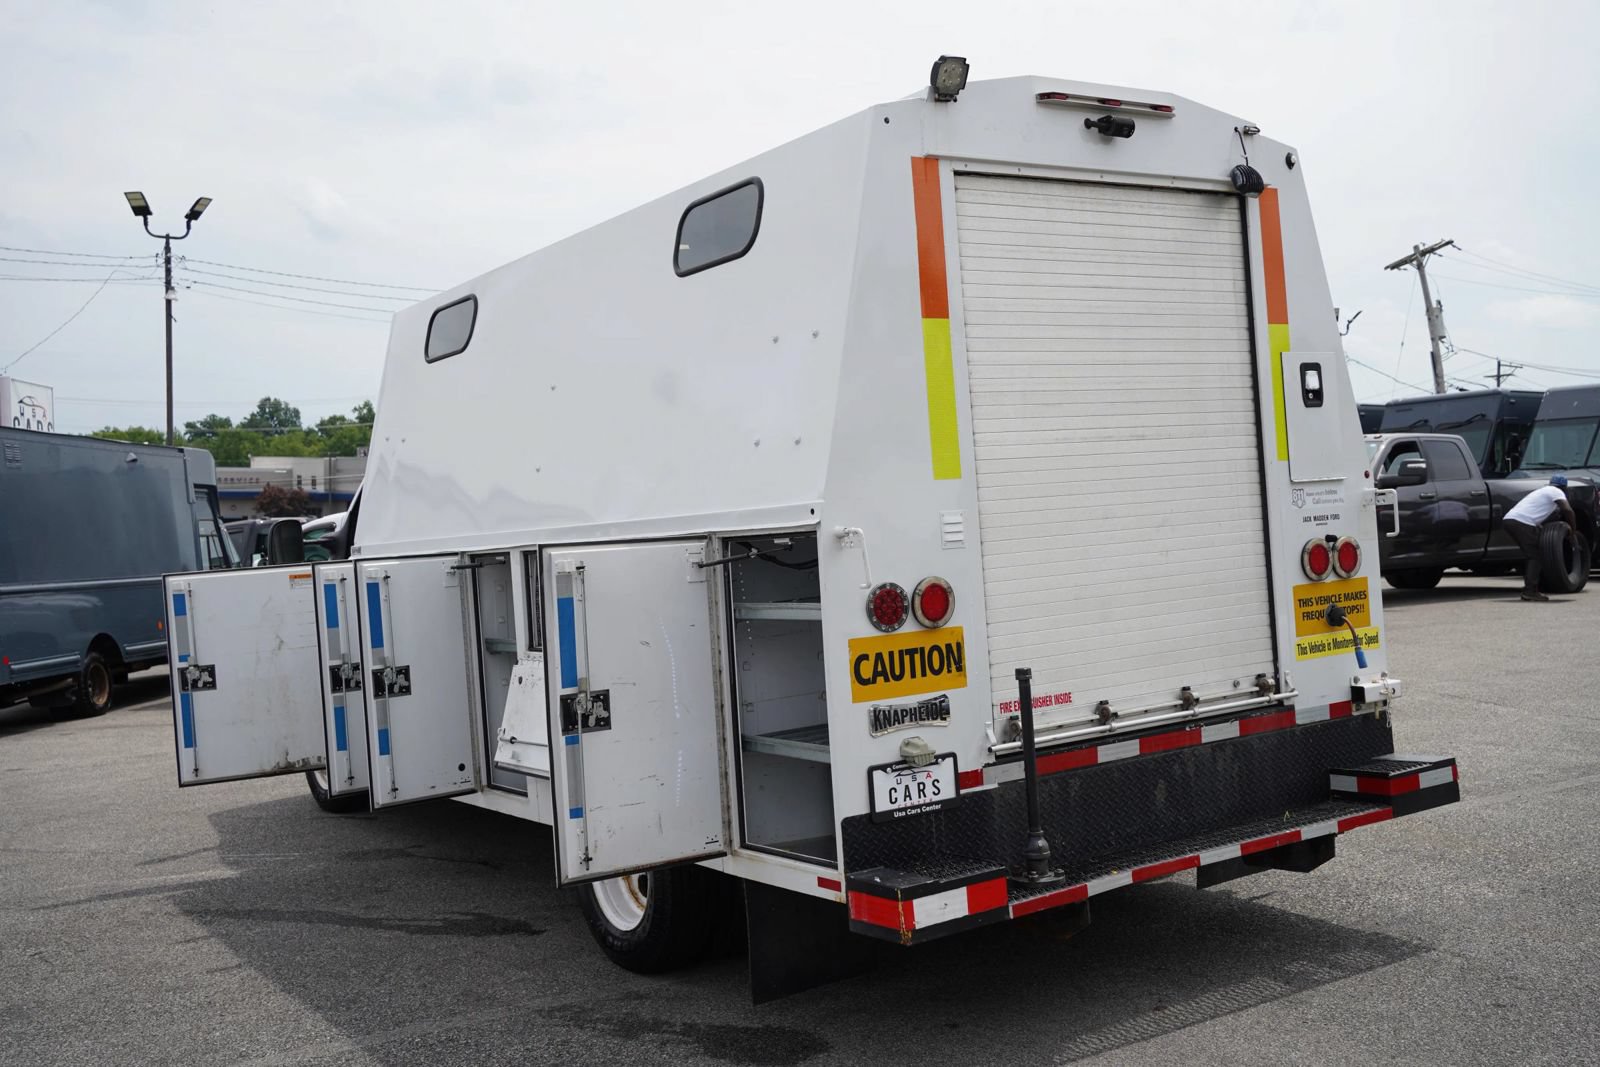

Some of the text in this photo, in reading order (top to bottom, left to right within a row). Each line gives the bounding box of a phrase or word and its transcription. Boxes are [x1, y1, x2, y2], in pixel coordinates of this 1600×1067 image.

[1298, 591, 1367, 608] THIS VEHICLE MAKES
[1302, 608, 1325, 621] FREQU
[1297, 643, 1308, 656] This
[1308, 640, 1327, 654] Vehicle
[1327, 638, 1332, 651] is
[1364, 631, 1379, 648] Speed
[854, 642, 962, 686] CAUTION
[1000, 702, 1012, 714] FIRE
[1054, 692, 1072, 705] INSIDE
[873, 700, 948, 732] KNAPHEIDE
[888, 778, 941, 804] CARS
[894, 803, 942, 818] Usa Cars Center
